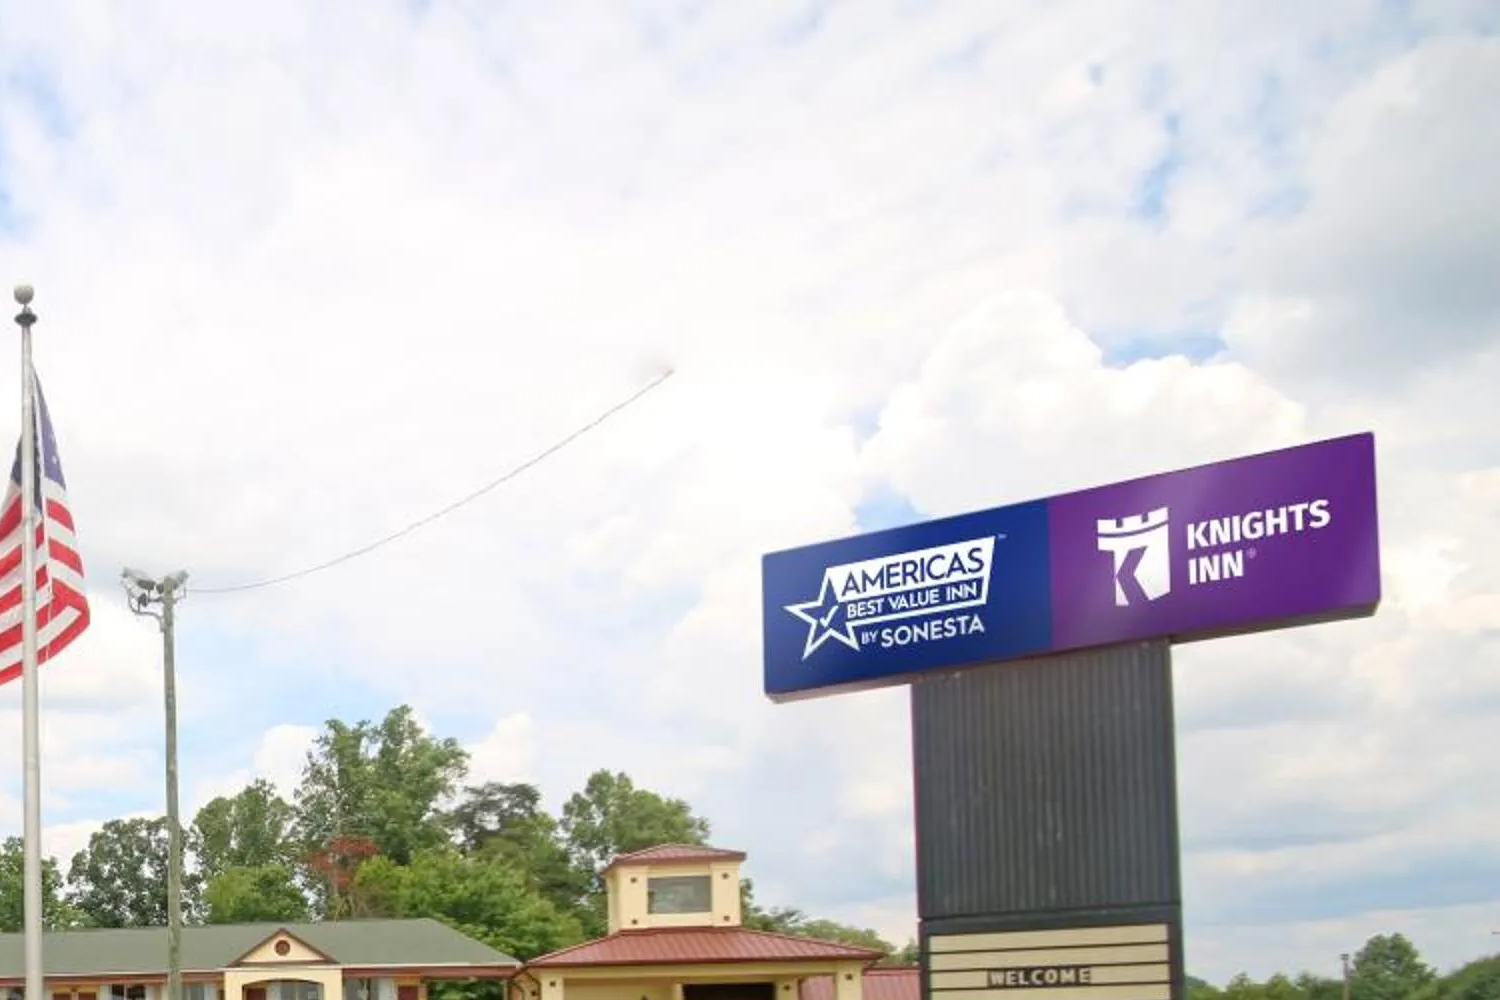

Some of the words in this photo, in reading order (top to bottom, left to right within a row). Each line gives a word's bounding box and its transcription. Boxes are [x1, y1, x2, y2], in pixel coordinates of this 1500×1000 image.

[1187, 499, 1331, 550] KNIGHTS
[841, 547, 985, 596] AMERICAS
[1188, 550, 1244, 585] INN
[847, 600, 884, 618] BEST
[888, 589, 940, 611] VALUE
[946, 582, 978, 601] INN
[861, 630, 879, 645] BY
[881, 614, 985, 647] SONESTA
[990, 968, 1091, 985] WELCOME
